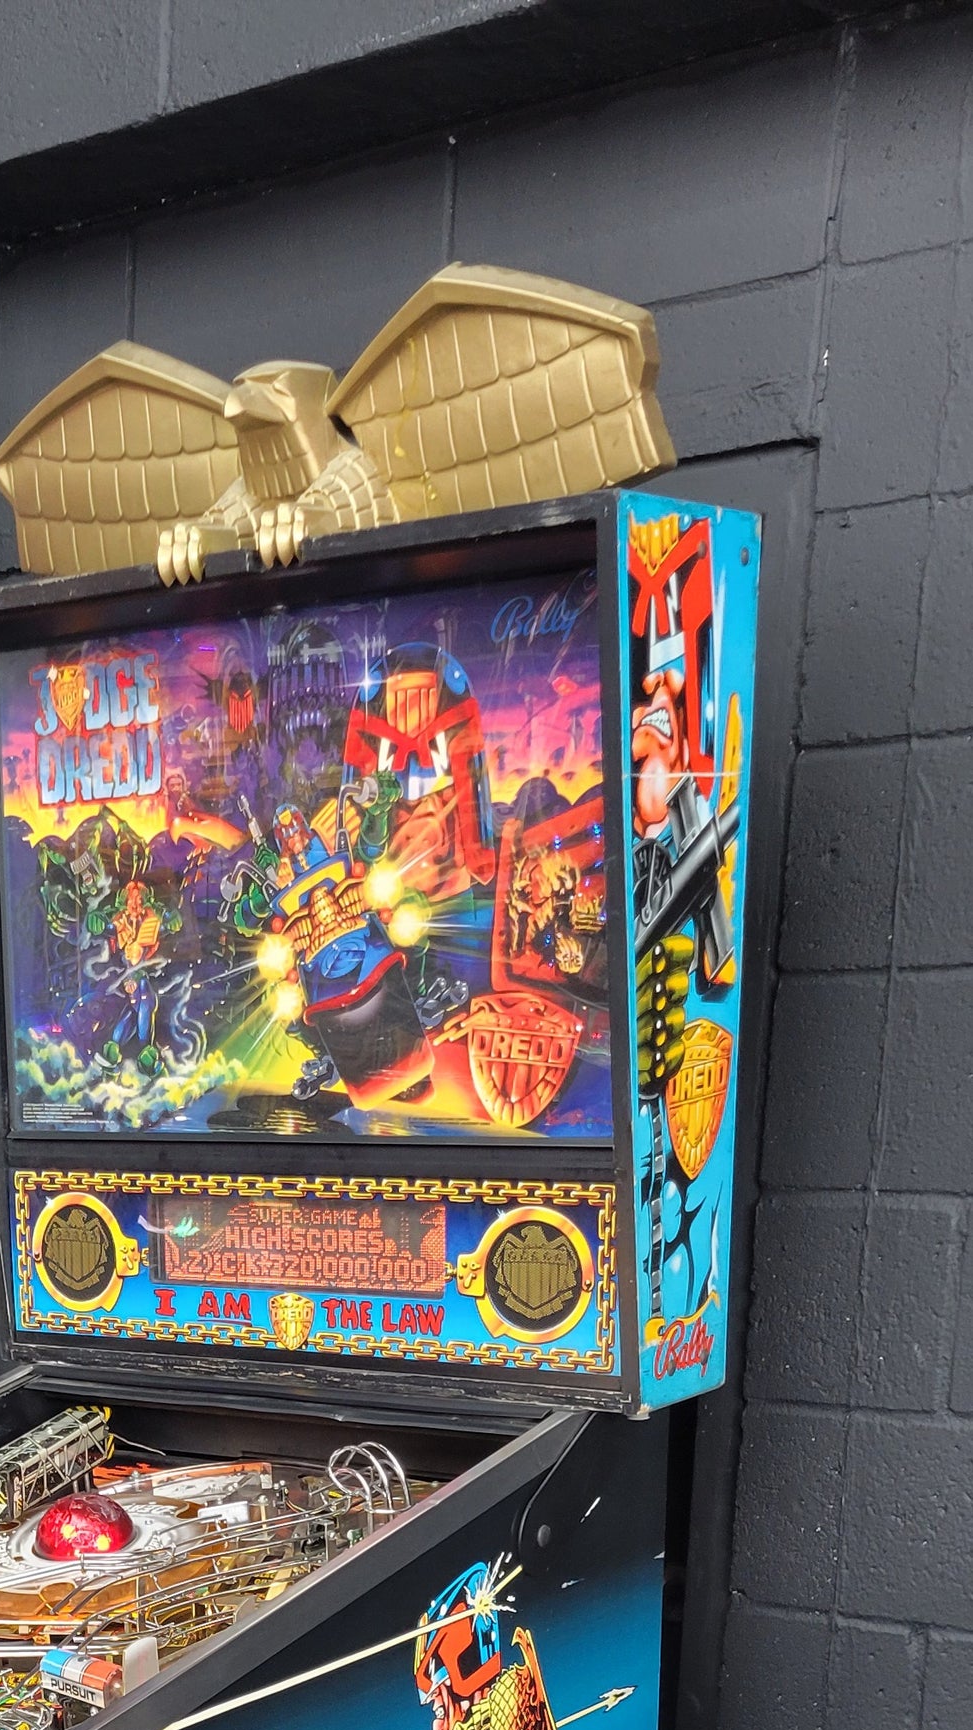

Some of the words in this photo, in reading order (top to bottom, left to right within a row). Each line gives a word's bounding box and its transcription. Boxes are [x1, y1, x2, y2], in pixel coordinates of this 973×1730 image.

[490, 594, 580, 645] Bally
[30, 652, 160, 736] JUDGE
[37, 727, 163, 805] DREDD
[473, 1030, 574, 1063] DREDD
[665, 1058, 729, 1103] DREDD
[225, 1226, 281, 1250] HIGH
[291, 1228, 384, 1254] SCORES
[249, 1207, 303, 1225] SUPER
[310, 1209, 358, 1226] GAME
[154, 1288, 177, 1317] I
[197, 1291, 252, 1321] AM
[321, 1298, 374, 1331] THE
[382, 1303, 445, 1337] LAW
[653, 1316, 715, 1380] Bally
[50, 1677, 97, 1702] PURSUIT
